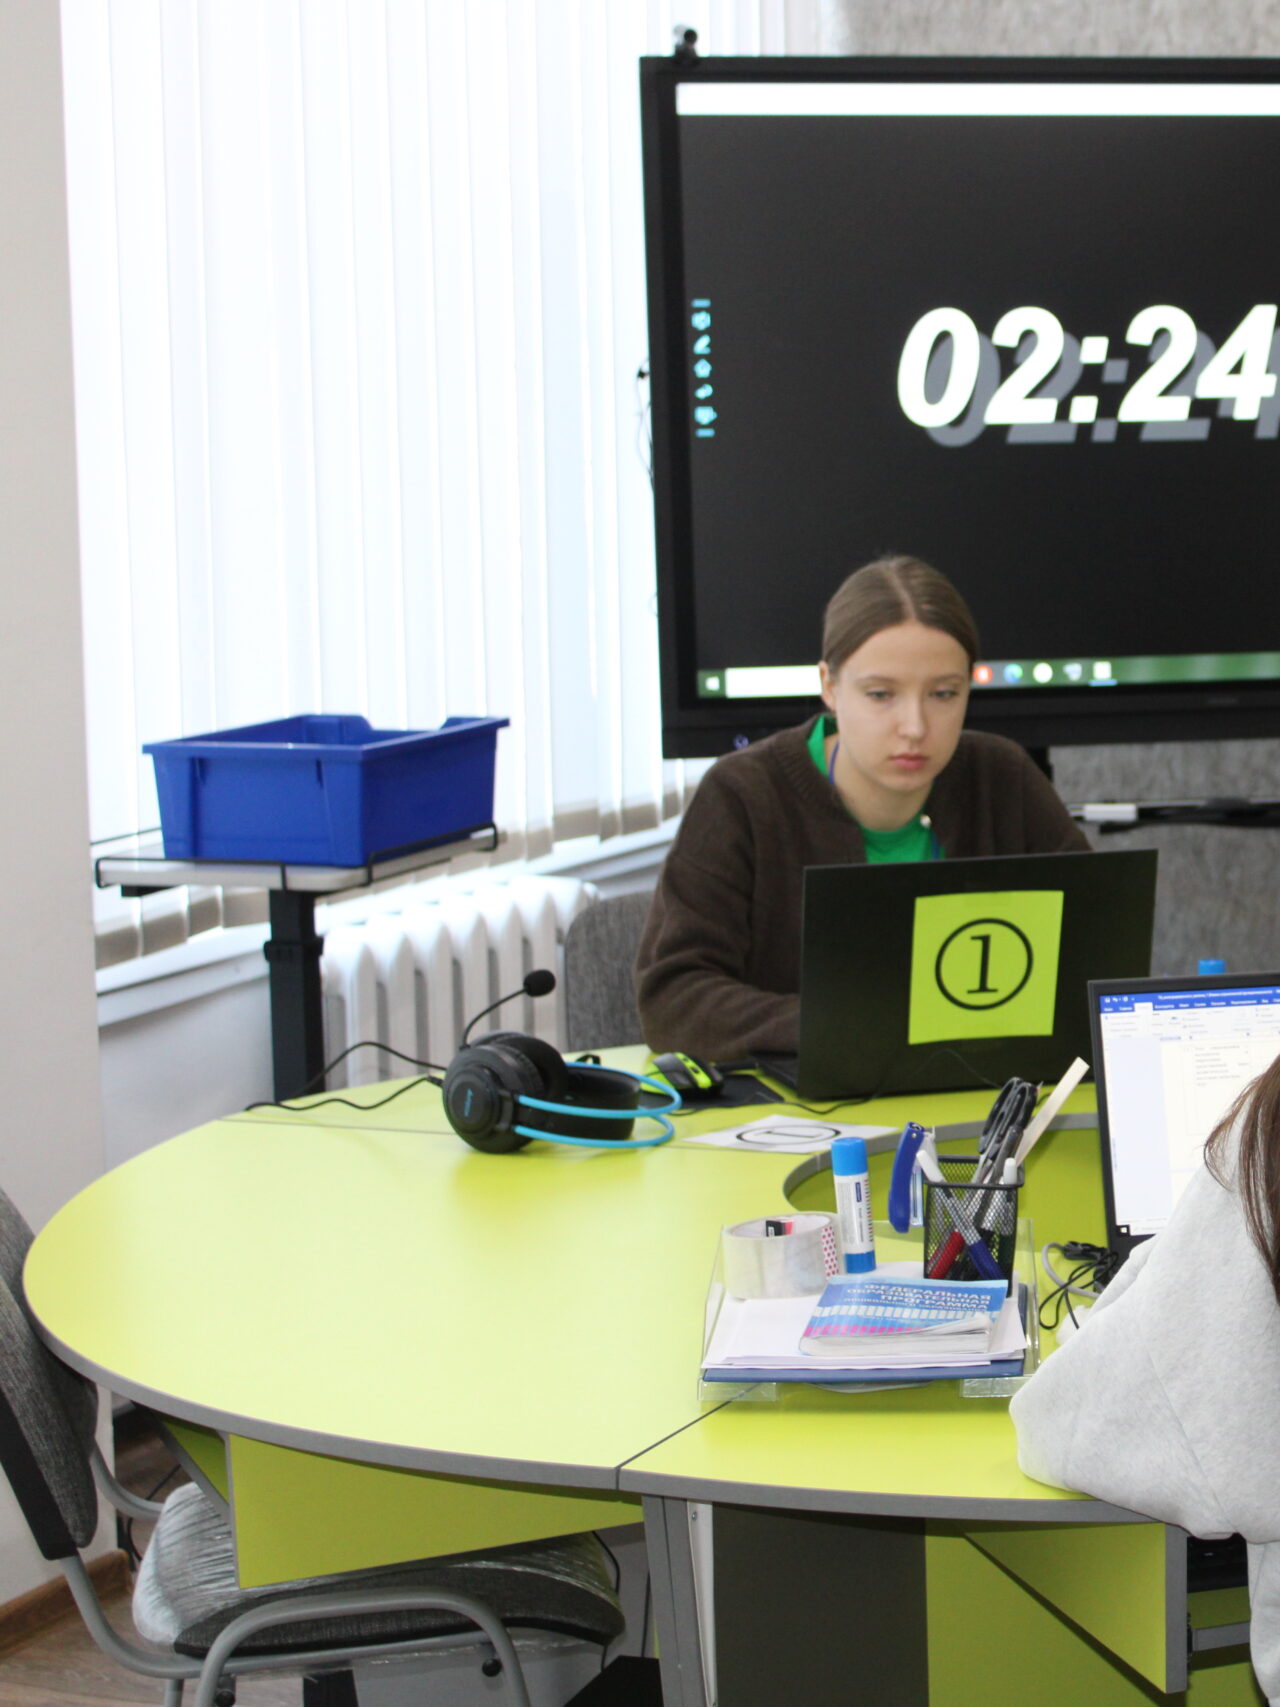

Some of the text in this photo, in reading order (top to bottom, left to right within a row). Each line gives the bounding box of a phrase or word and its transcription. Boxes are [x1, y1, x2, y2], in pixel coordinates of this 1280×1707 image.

[966, 933, 999, 995] 1
[847, 1288, 990, 1305] ОБРАЗОВАТЕЛЬНАЯ
[864, 1284, 992, 1300] ФЕДЕРАЛЬНАЯ
[881, 1294, 988, 1311] ПРОГРАММА
